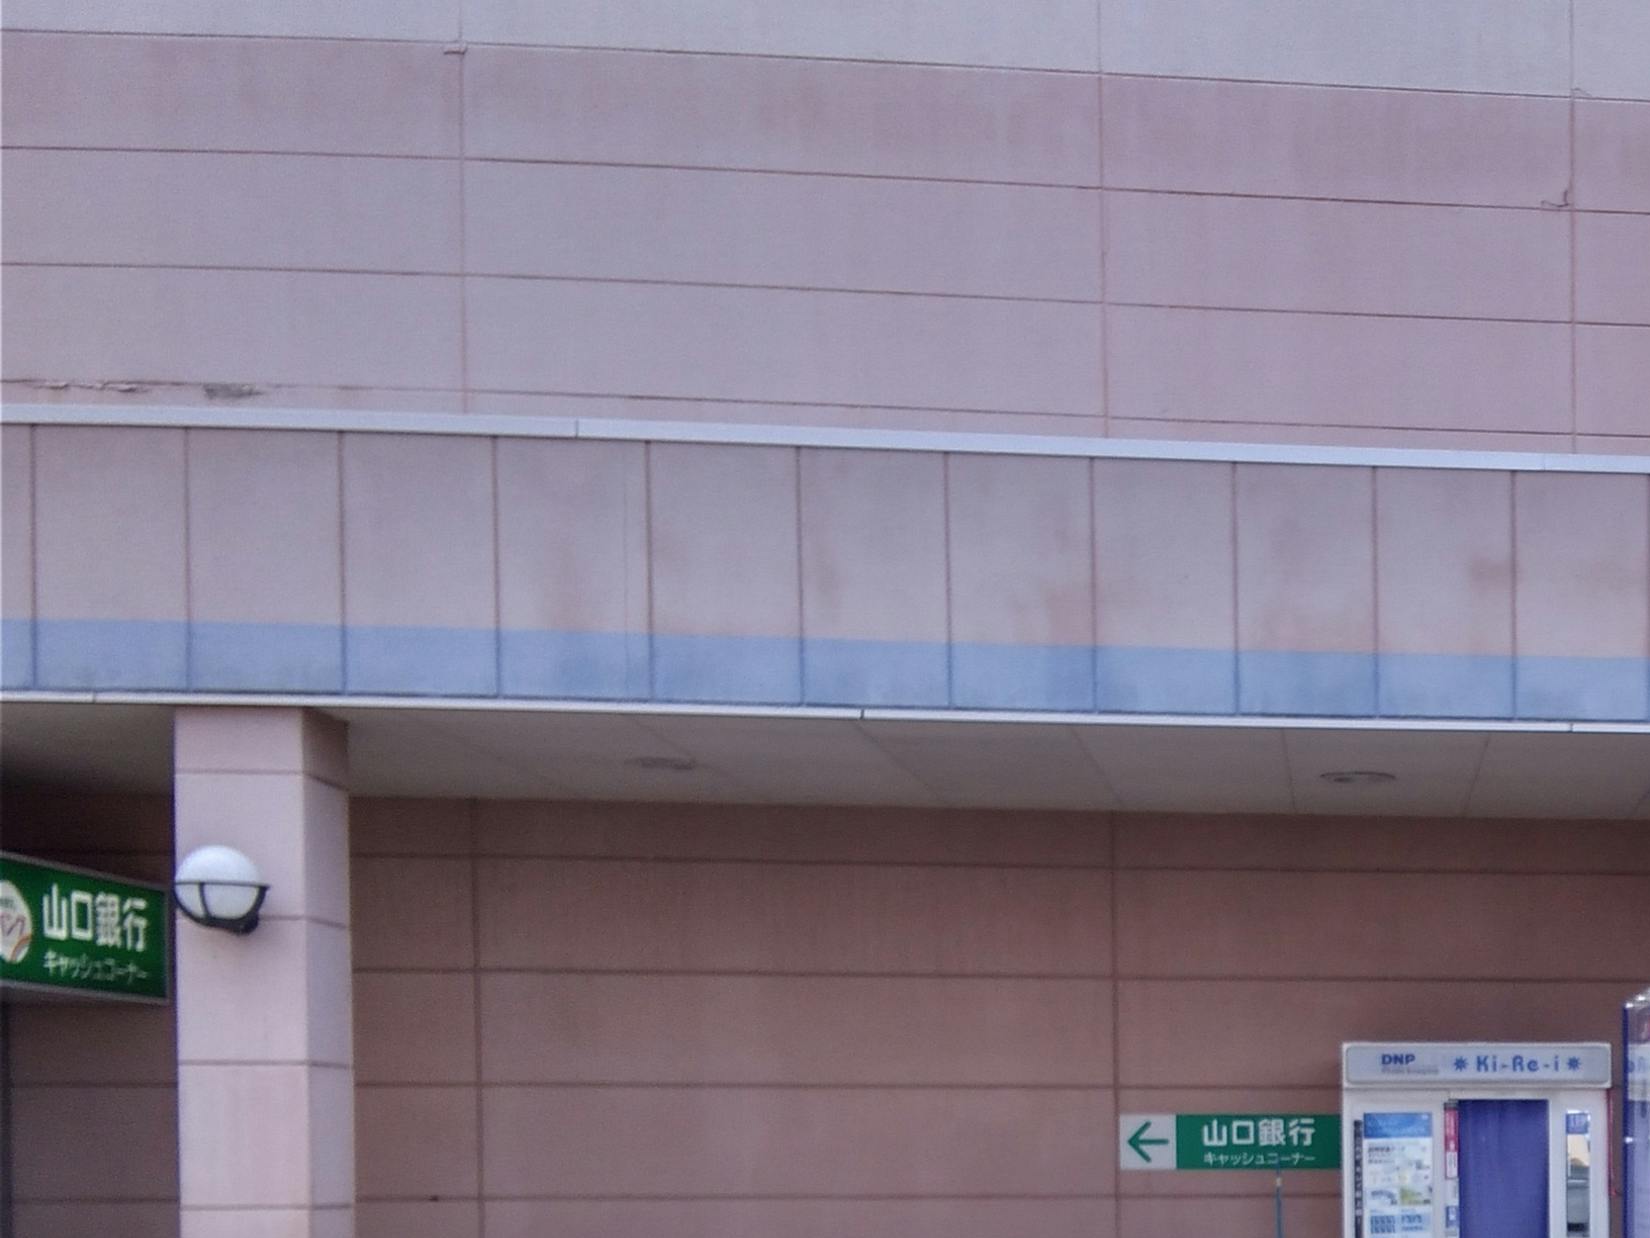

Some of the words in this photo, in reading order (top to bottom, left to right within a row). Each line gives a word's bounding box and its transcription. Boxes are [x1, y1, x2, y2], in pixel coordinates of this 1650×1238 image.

[42, 883, 148, 952] 山口銀行
[44, 950, 148, 983] キャッシュコーナー
[1381, 1054, 1415, 1065] DNP
[1203, 1118, 1316, 1146] 山口銀行
[1203, 1151, 1316, 1166] キャッシュコーナー
